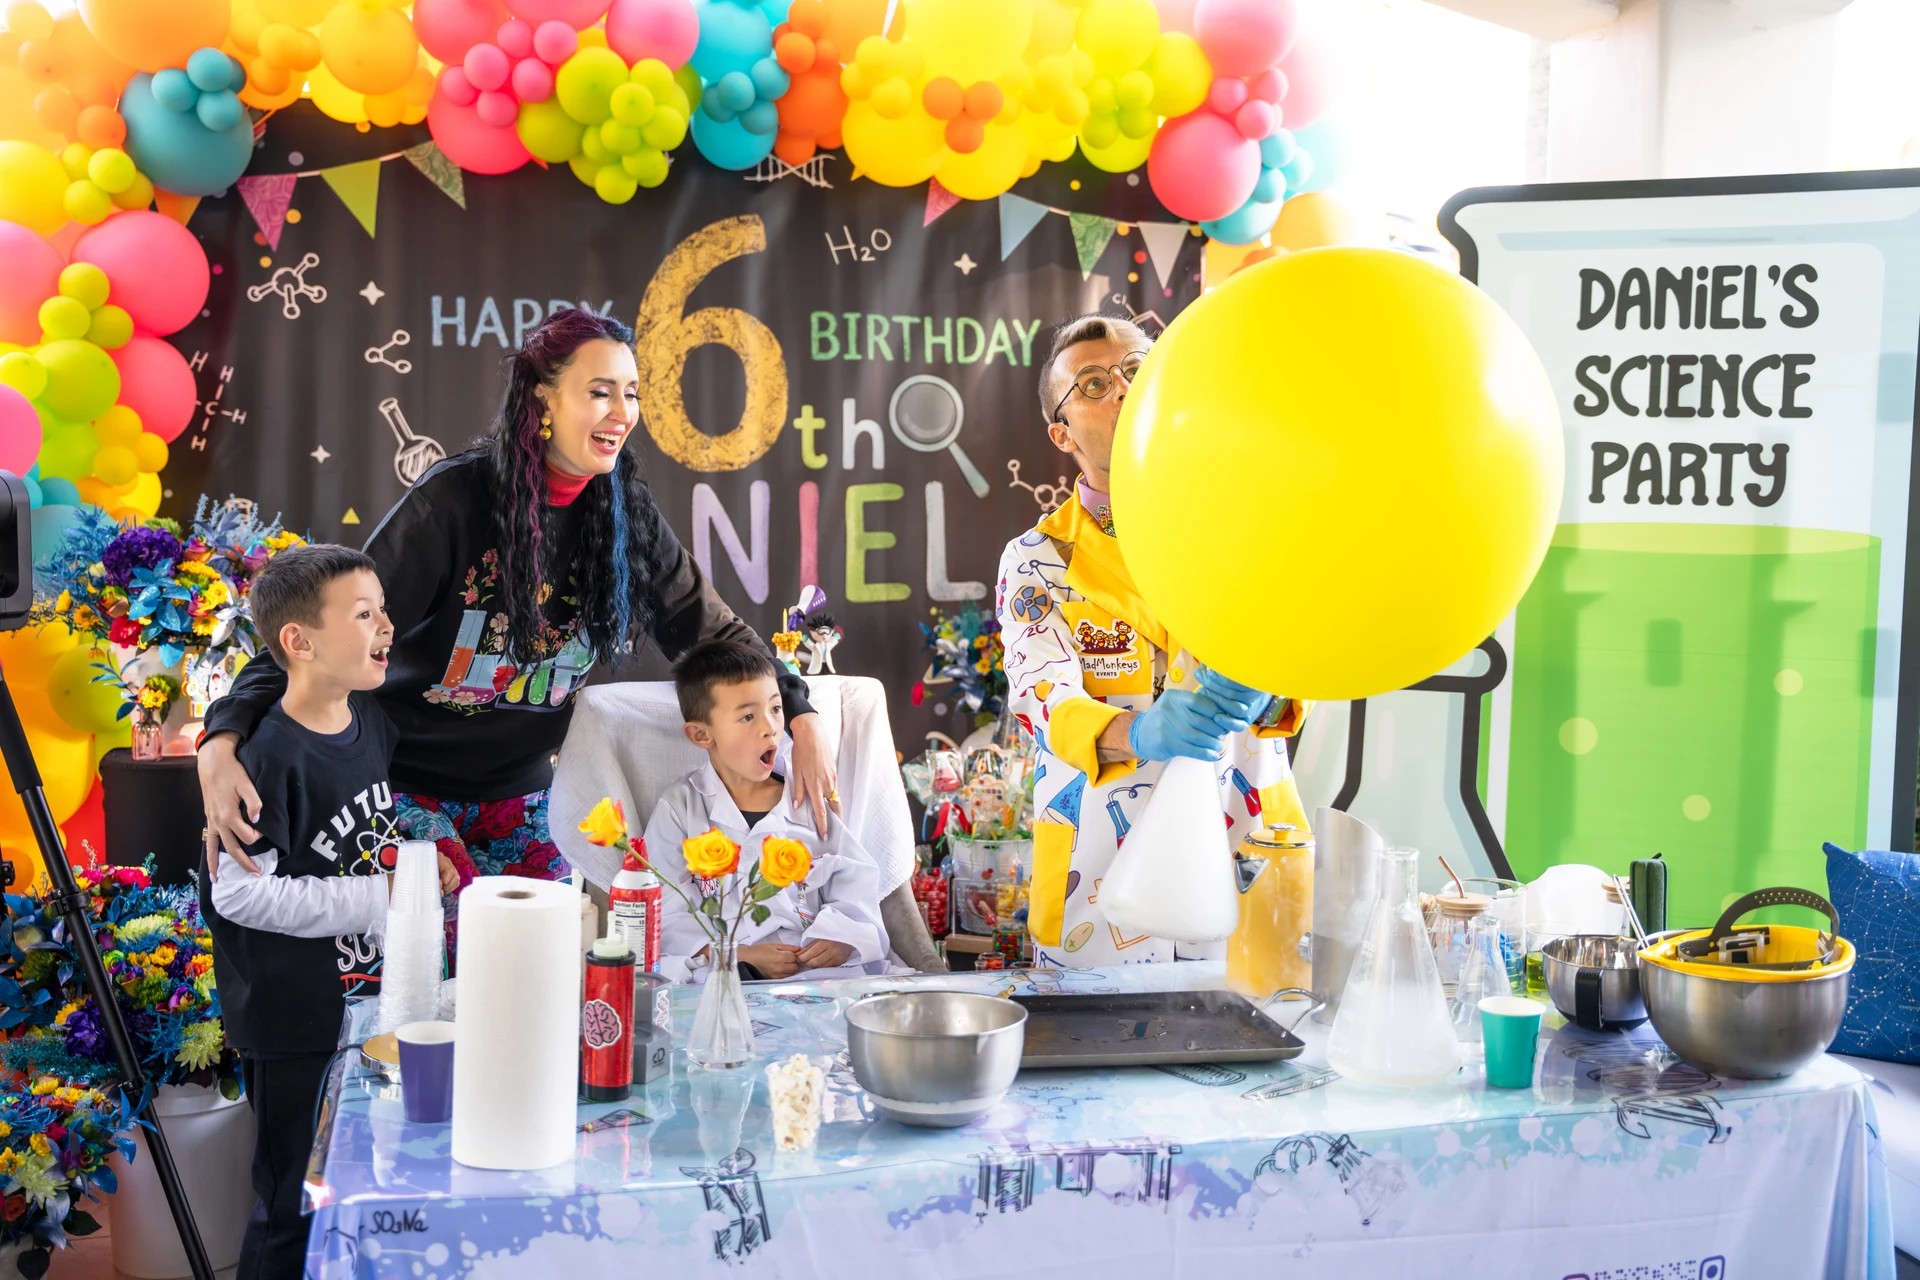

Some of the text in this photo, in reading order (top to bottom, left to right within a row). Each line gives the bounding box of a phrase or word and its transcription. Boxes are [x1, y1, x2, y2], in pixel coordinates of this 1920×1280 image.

[810, 311, 1042, 367] BIRTHDAY
[1573, 353, 1817, 418] SCIENCE
[1588, 441, 1790, 508] PARTY
